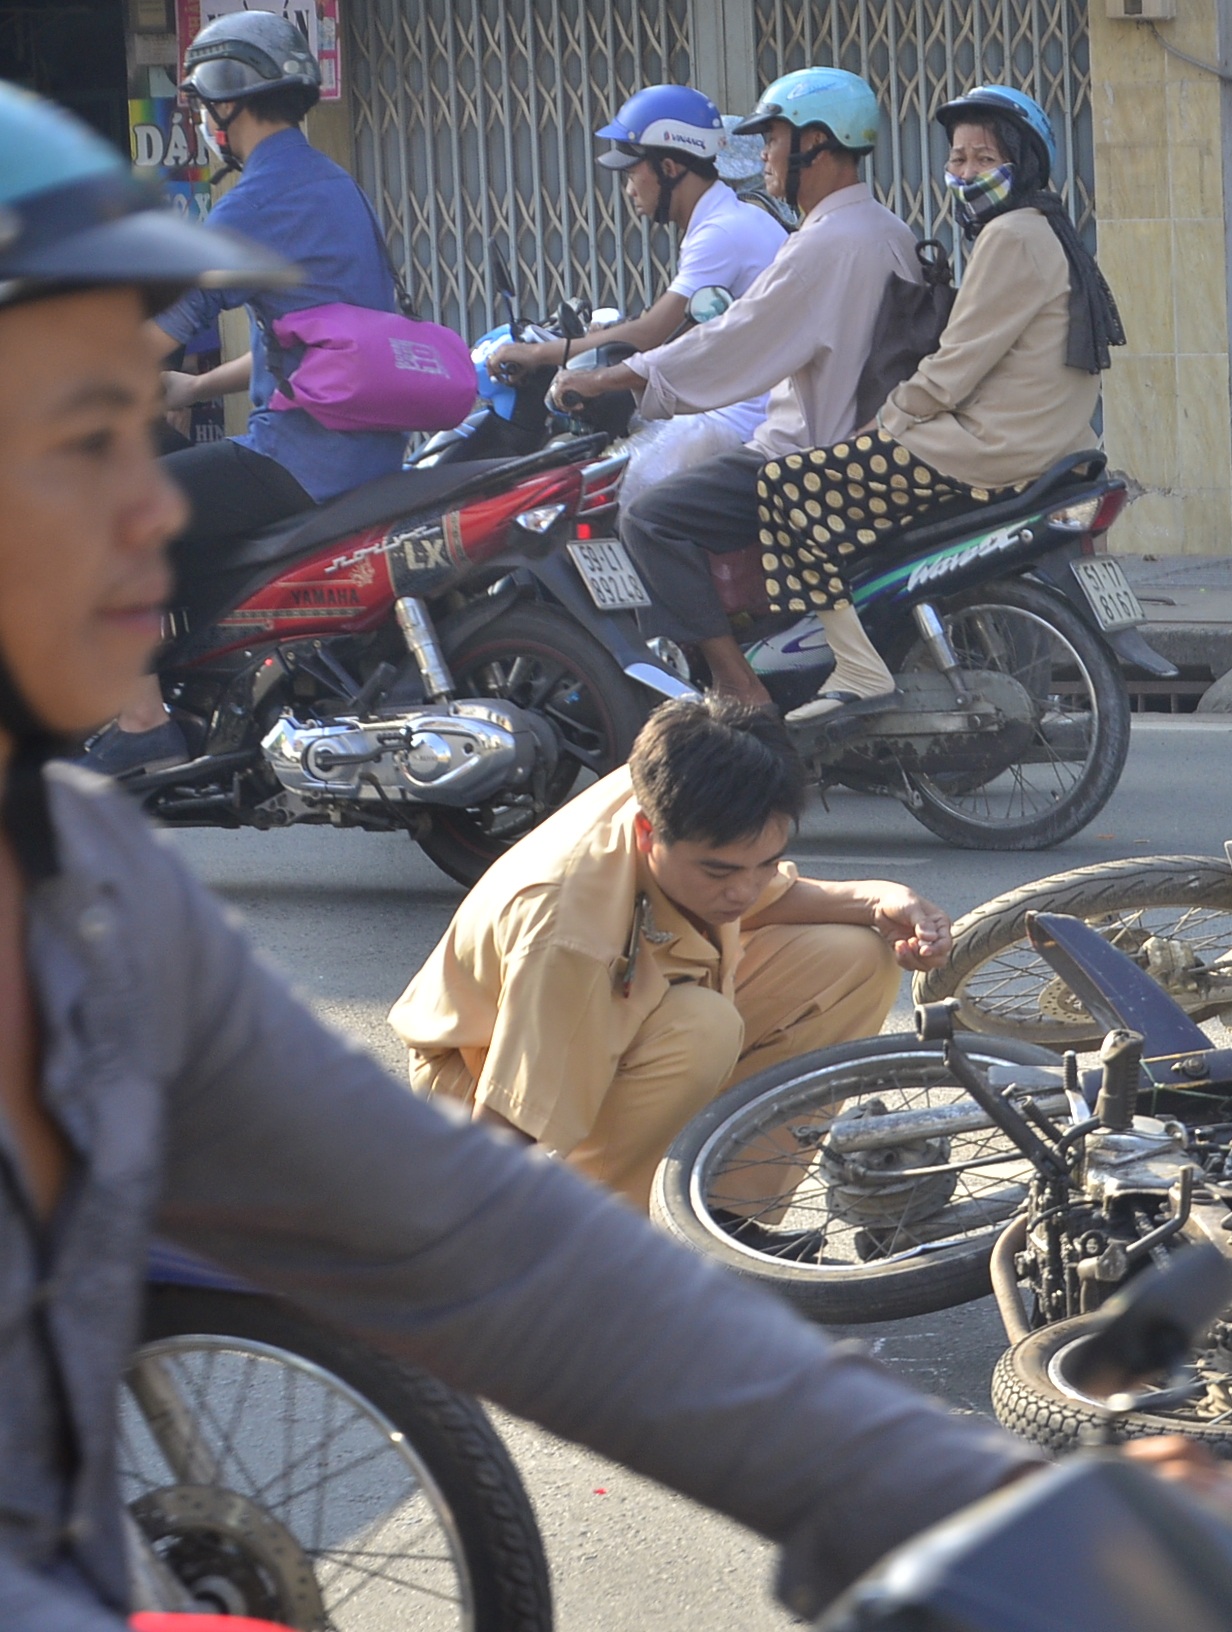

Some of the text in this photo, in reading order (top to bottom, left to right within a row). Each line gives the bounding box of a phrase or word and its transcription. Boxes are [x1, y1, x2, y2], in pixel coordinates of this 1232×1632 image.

[402, 538, 451, 571] LX
[578, 544, 624, 573] 59-L1
[1082, 561, 1122, 592] 51-T7
[290, 587, 362, 605] YAMAHA
[1099, 590, 1137, 620] 8167
